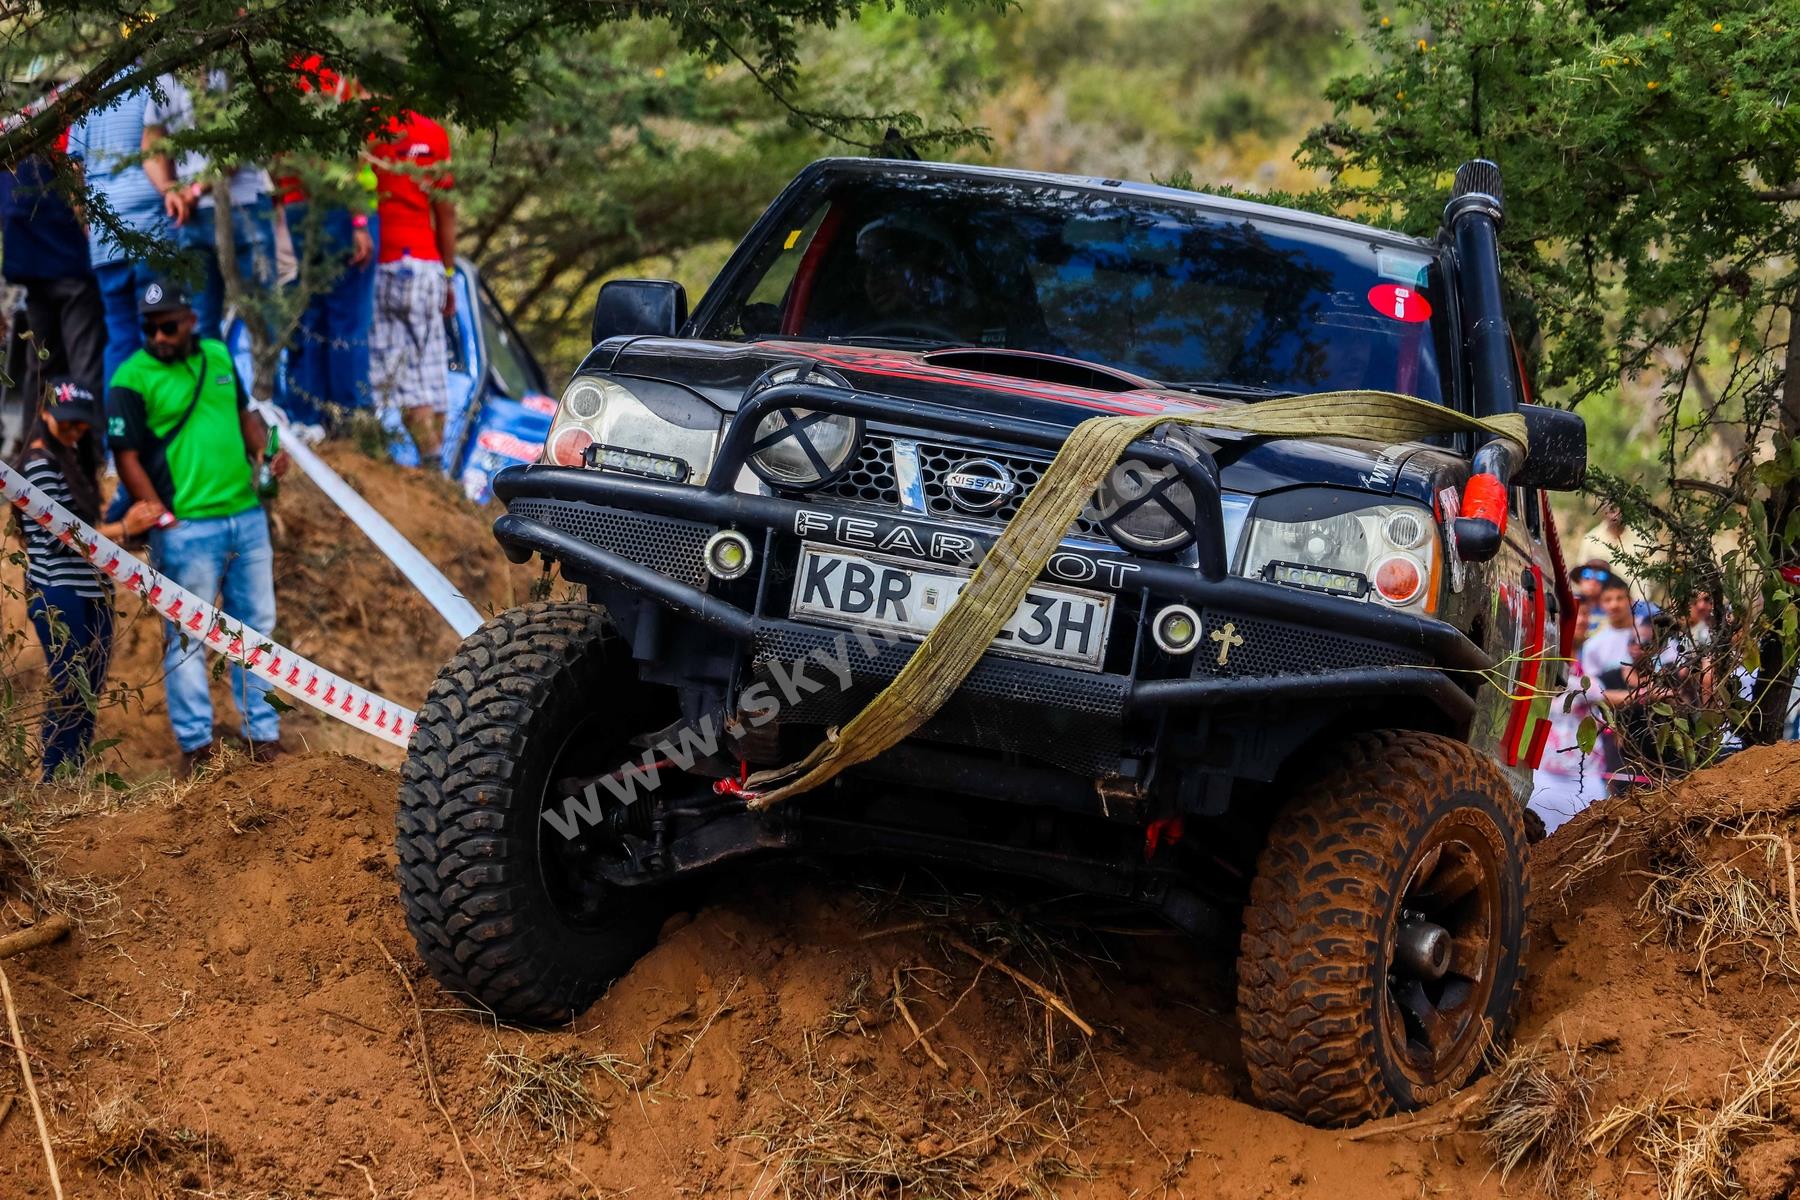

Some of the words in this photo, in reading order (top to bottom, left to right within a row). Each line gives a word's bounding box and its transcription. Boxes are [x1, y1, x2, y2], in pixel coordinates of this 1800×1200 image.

[949, 473, 1007, 492] NISSAN
[794, 509, 975, 563] FEAR
[1045, 552, 1142, 589] OT
[802, 554, 912, 622] KBR
[957, 586, 1096, 654] 3H
